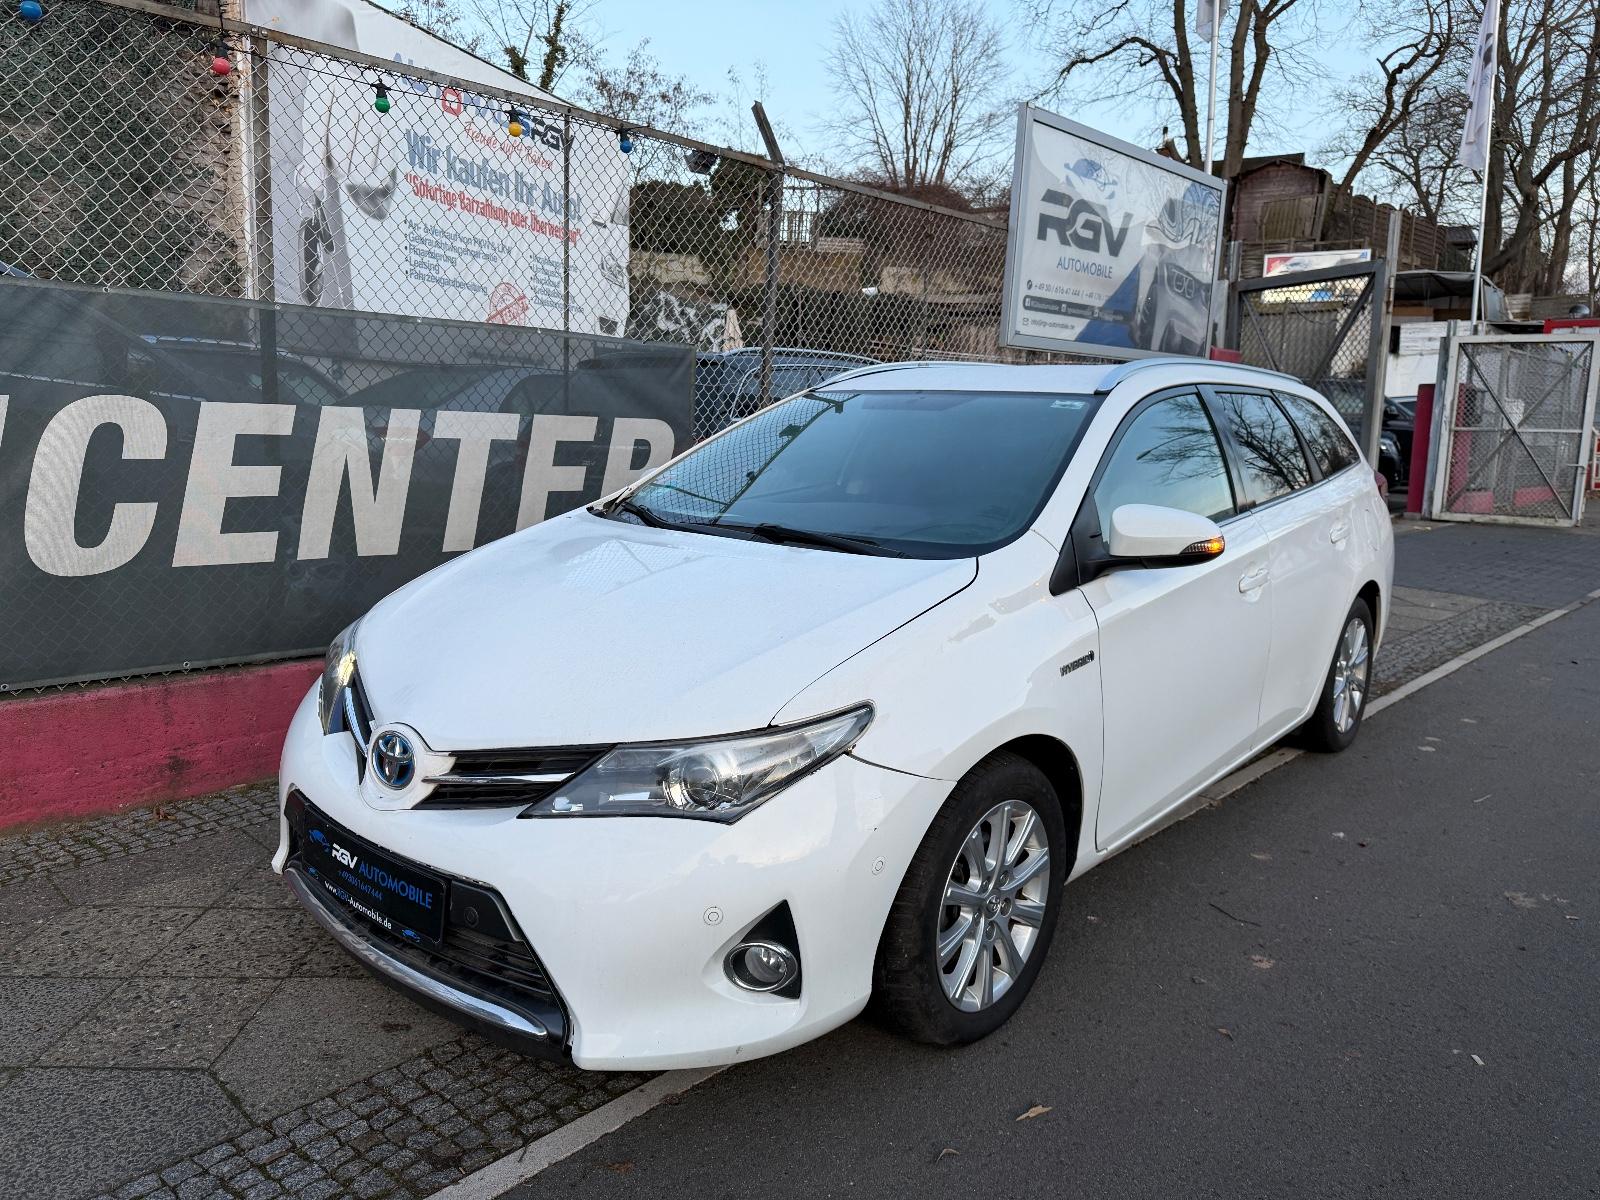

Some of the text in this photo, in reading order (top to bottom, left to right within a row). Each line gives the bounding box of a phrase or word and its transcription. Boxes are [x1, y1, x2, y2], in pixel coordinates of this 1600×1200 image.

[465, 121, 498, 149] Freude
[406, 128, 441, 175] Wir
[446, 145, 510, 197] kaufen
[514, 171, 538, 207] Ihr
[459, 191, 509, 228] Barzahlung
[510, 208, 528, 230] oder
[1036, 188, 1134, 258] RGV
[409, 256, 440, 274] Leasing
[1056, 256, 1113, 280] AUTOMOBILE
[331, 842, 434, 910] RGV AUTOMOBILE
